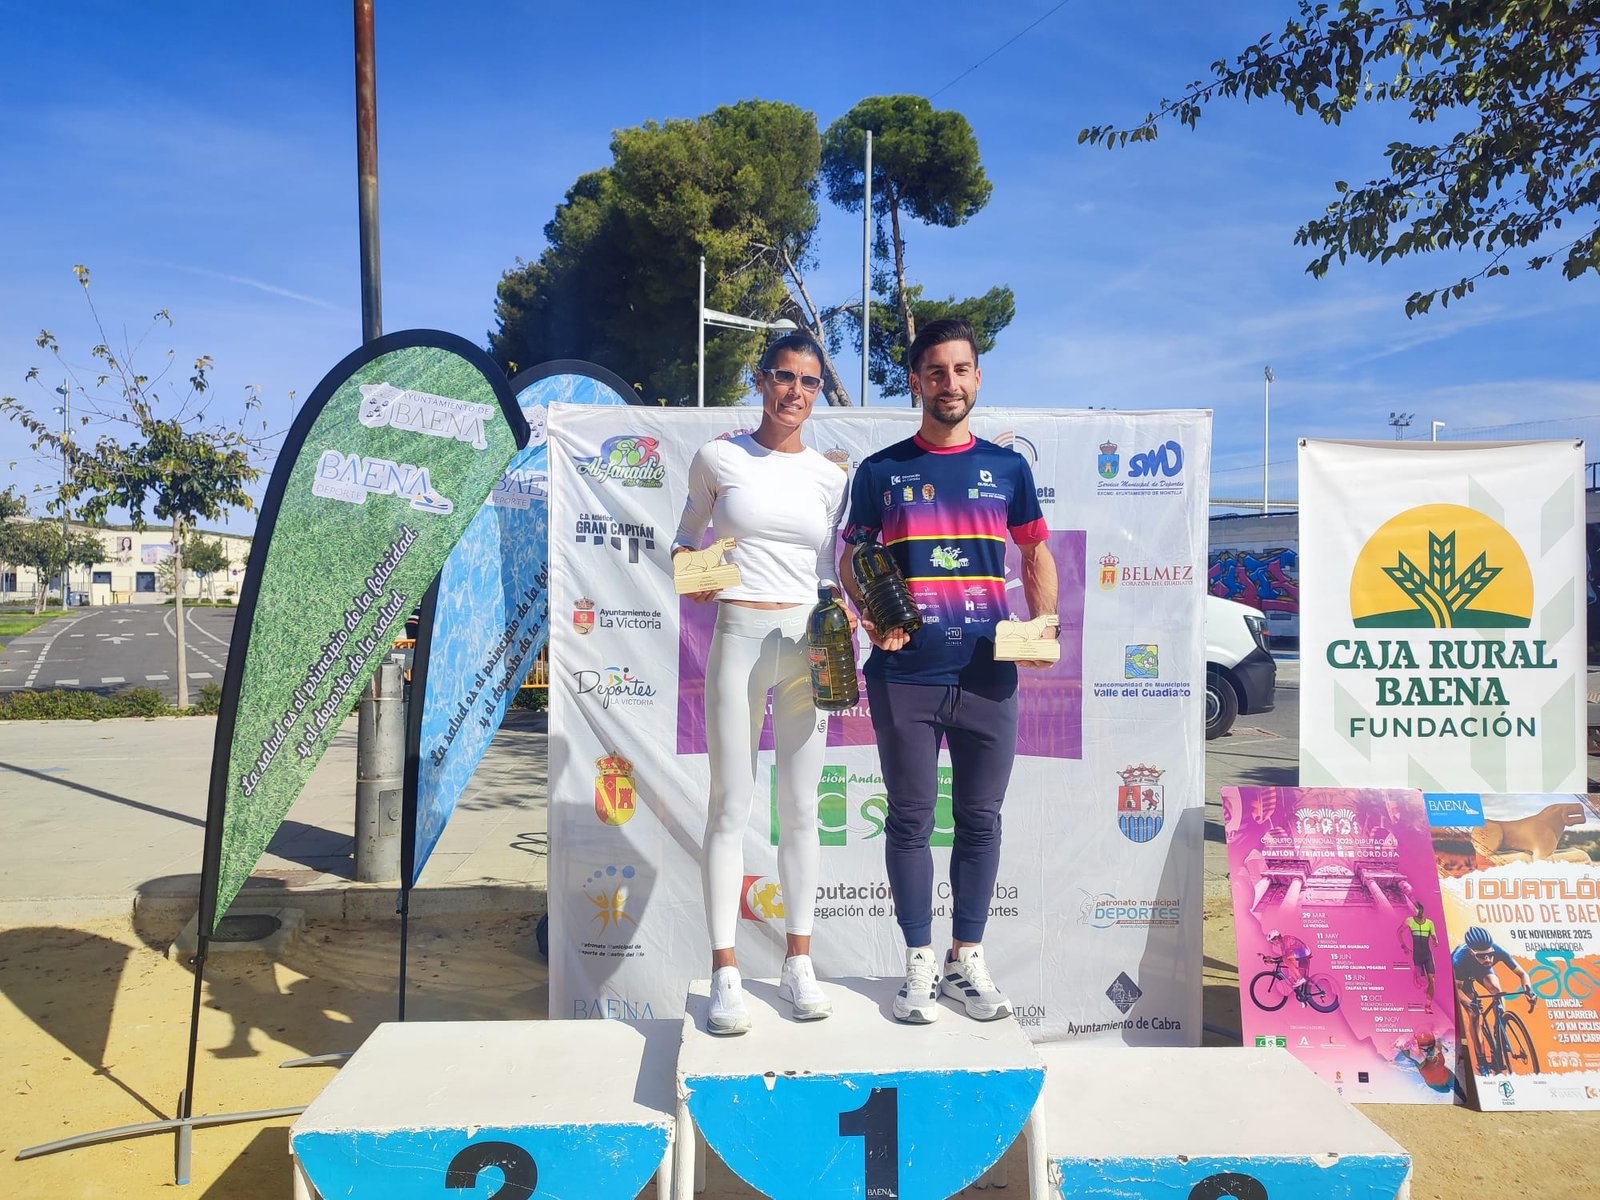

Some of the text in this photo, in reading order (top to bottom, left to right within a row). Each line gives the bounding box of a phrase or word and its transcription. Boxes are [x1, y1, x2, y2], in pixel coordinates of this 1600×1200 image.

[402, 390, 490, 414] AYUNTAMIENTO DE
[394, 403, 482, 444] BAENA
[320, 453, 428, 494] BAENA
[315, 484, 363, 501] DEPORTE
[491, 471, 547, 497] BAE
[1036, 486, 1055, 498] eta
[1121, 480, 1149, 488] Municipal
[1160, 480, 1184, 488] Deportes
[495, 496, 528, 507] EPORTE
[576, 521, 654, 539] GRAN CAPITÁN
[1122, 566, 1193, 581] BELMEZ
[600, 608, 651, 617] Ayuntamiento
[600, 617, 661, 630] La Victoria
[353, 635, 377, 657] la
[240, 525, 419, 797] La salud es el principio de la felicidad,
[1326, 640, 1558, 671] CAJA RURAL
[348, 653, 365, 677] de
[430, 586, 540, 767] La salud es el principio de la
[479, 622, 541, 729] y el deporte de la
[573, 670, 656, 709] Deportes
[1094, 688, 1191, 698] Valle del Guadiato
[1376, 677, 1510, 706] BAENA
[314, 671, 354, 728] deporte
[621, 698, 654, 706] VICTORIA
[1350, 711, 1536, 738] FUNDACIÓN
[306, 723, 320, 745] el
[297, 743, 312, 759] y
[1428, 800, 1469, 811] BAENA
[815, 882, 892, 903] putació
[1465, 873, 1600, 900] I DUATLÓ
[813, 904, 864, 919] egación
[868, 904, 885, 917] de
[988, 905, 1018, 917] ortes
[1096, 898, 1180, 908] patronato municipal
[1095, 907, 1180, 920] DEPORTES
[1476, 904, 1535, 924] CIUDAD
[1540, 904, 1563, 923] DE
[1511, 929, 1593, 939] 9 DE NOVIEMBRE 2025
[1549, 939, 1584, 952] CÓRDOBA
[1369, 994, 1383, 1002] OCT
[1545, 998, 1583, 1008] DISTANCIA:
[574, 998, 655, 1019] BAENA
[1547, 1010, 1599, 1019] 5 KM CARRERA
[1020, 1018, 1041, 1026] ENSE
[1067, 1016, 1181, 1036] Ayuntamiento de Cabra
[1555, 1022, 1566, 1031] 20
[1566, 1022, 1578, 1031] KM
[1570, 1033, 1582, 1042] KM
[838, 1087, 898, 1200] 1
[867, 1188, 892, 1196] BAENA
